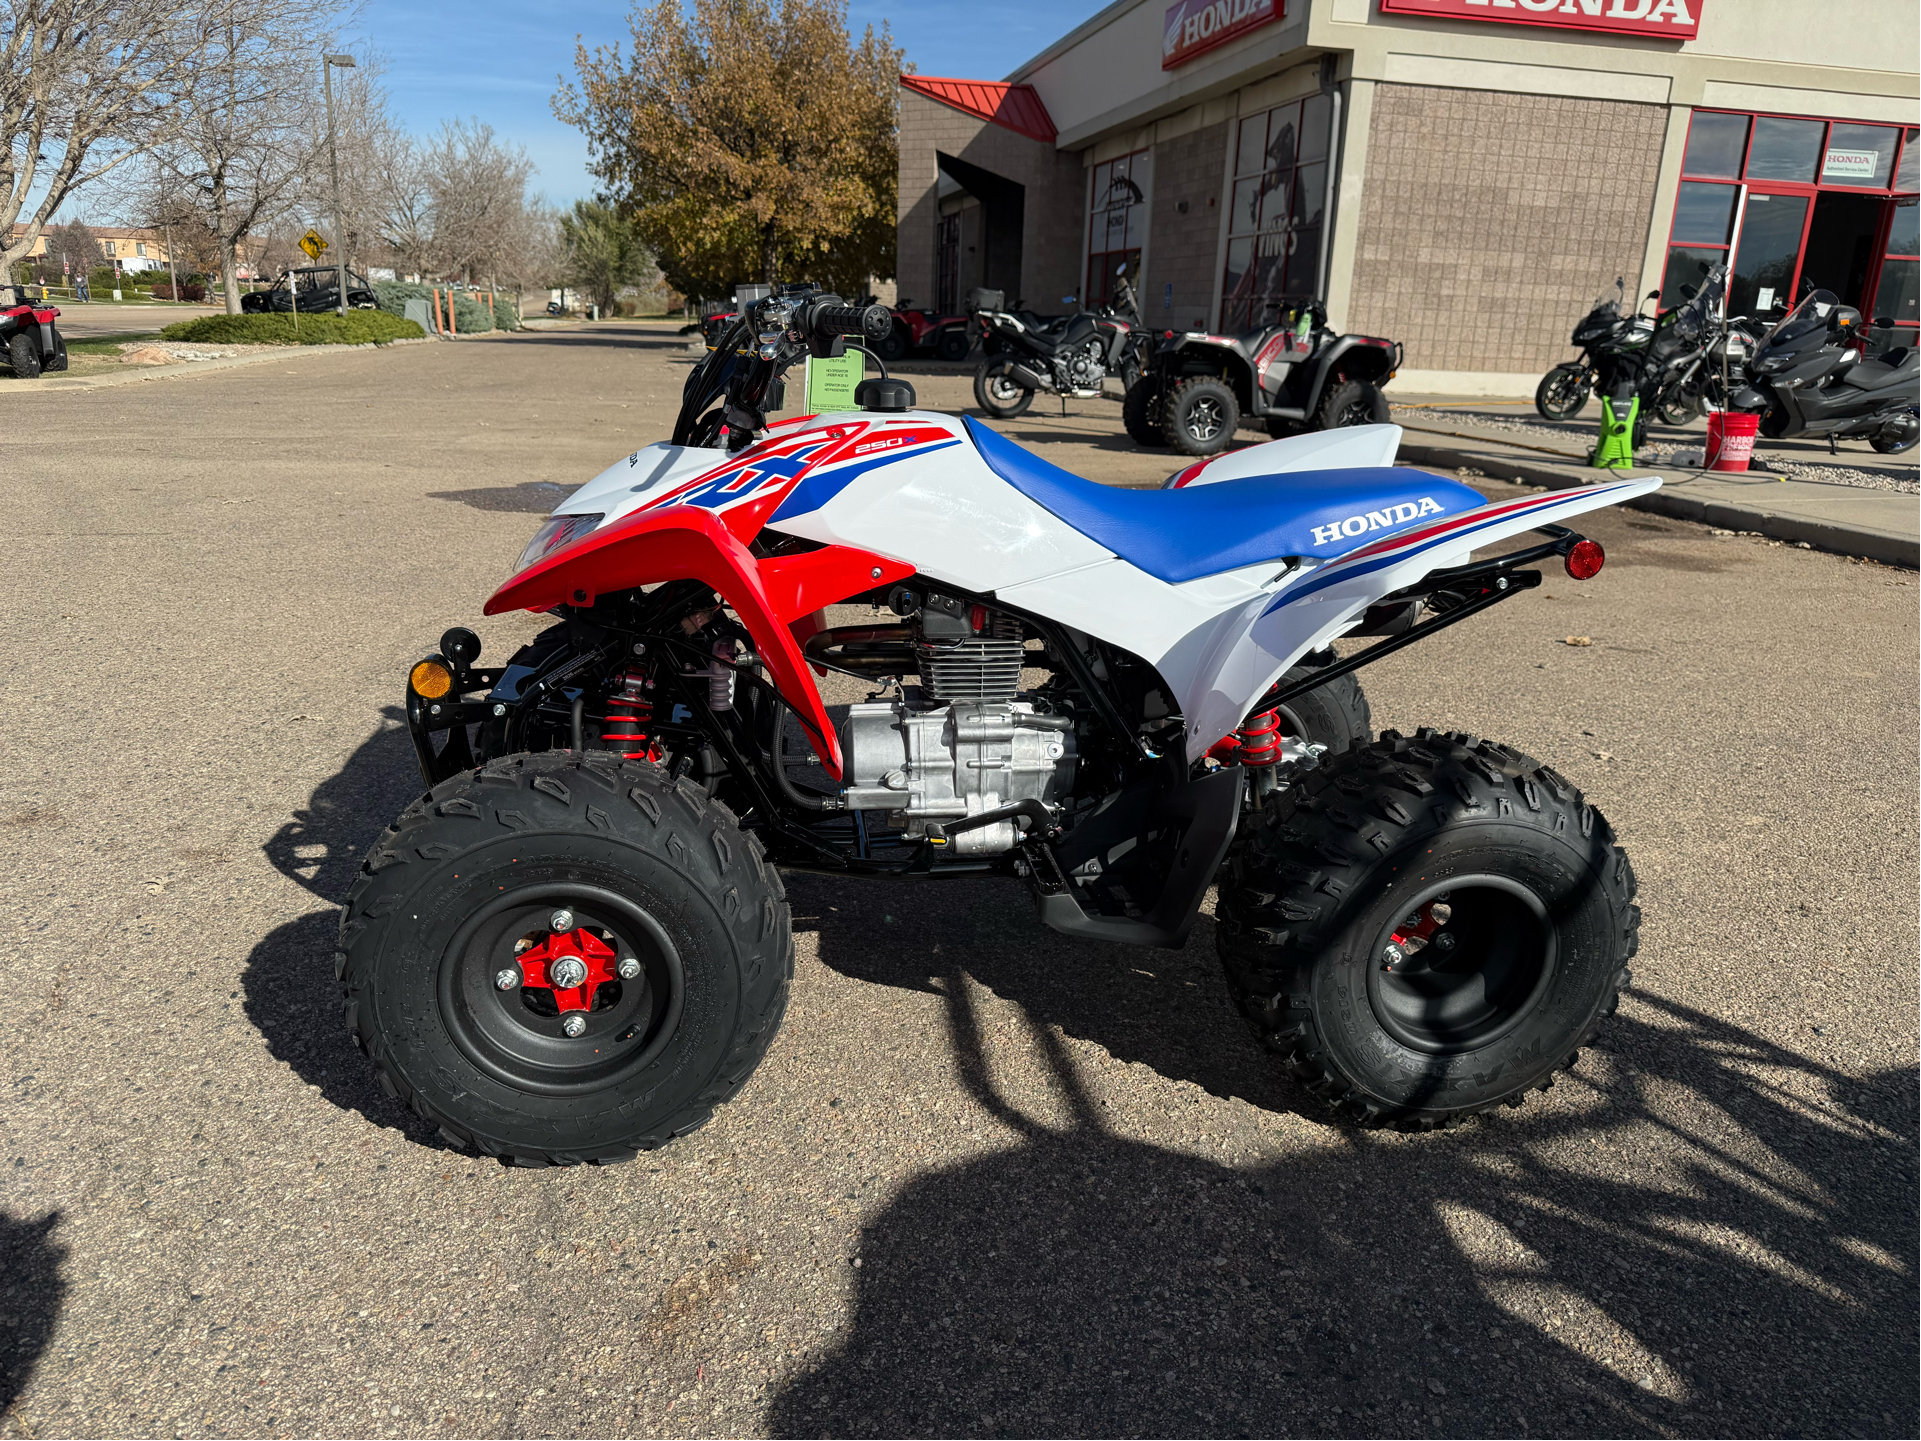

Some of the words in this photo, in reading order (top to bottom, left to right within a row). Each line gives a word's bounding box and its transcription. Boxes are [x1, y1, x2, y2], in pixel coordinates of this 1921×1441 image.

[1478, 0, 1695, 25] NDA
[1827, 155, 1870, 164] HONDA
[855, 435, 918, 454] 250X
[1310, 497, 1445, 546] HONDA
